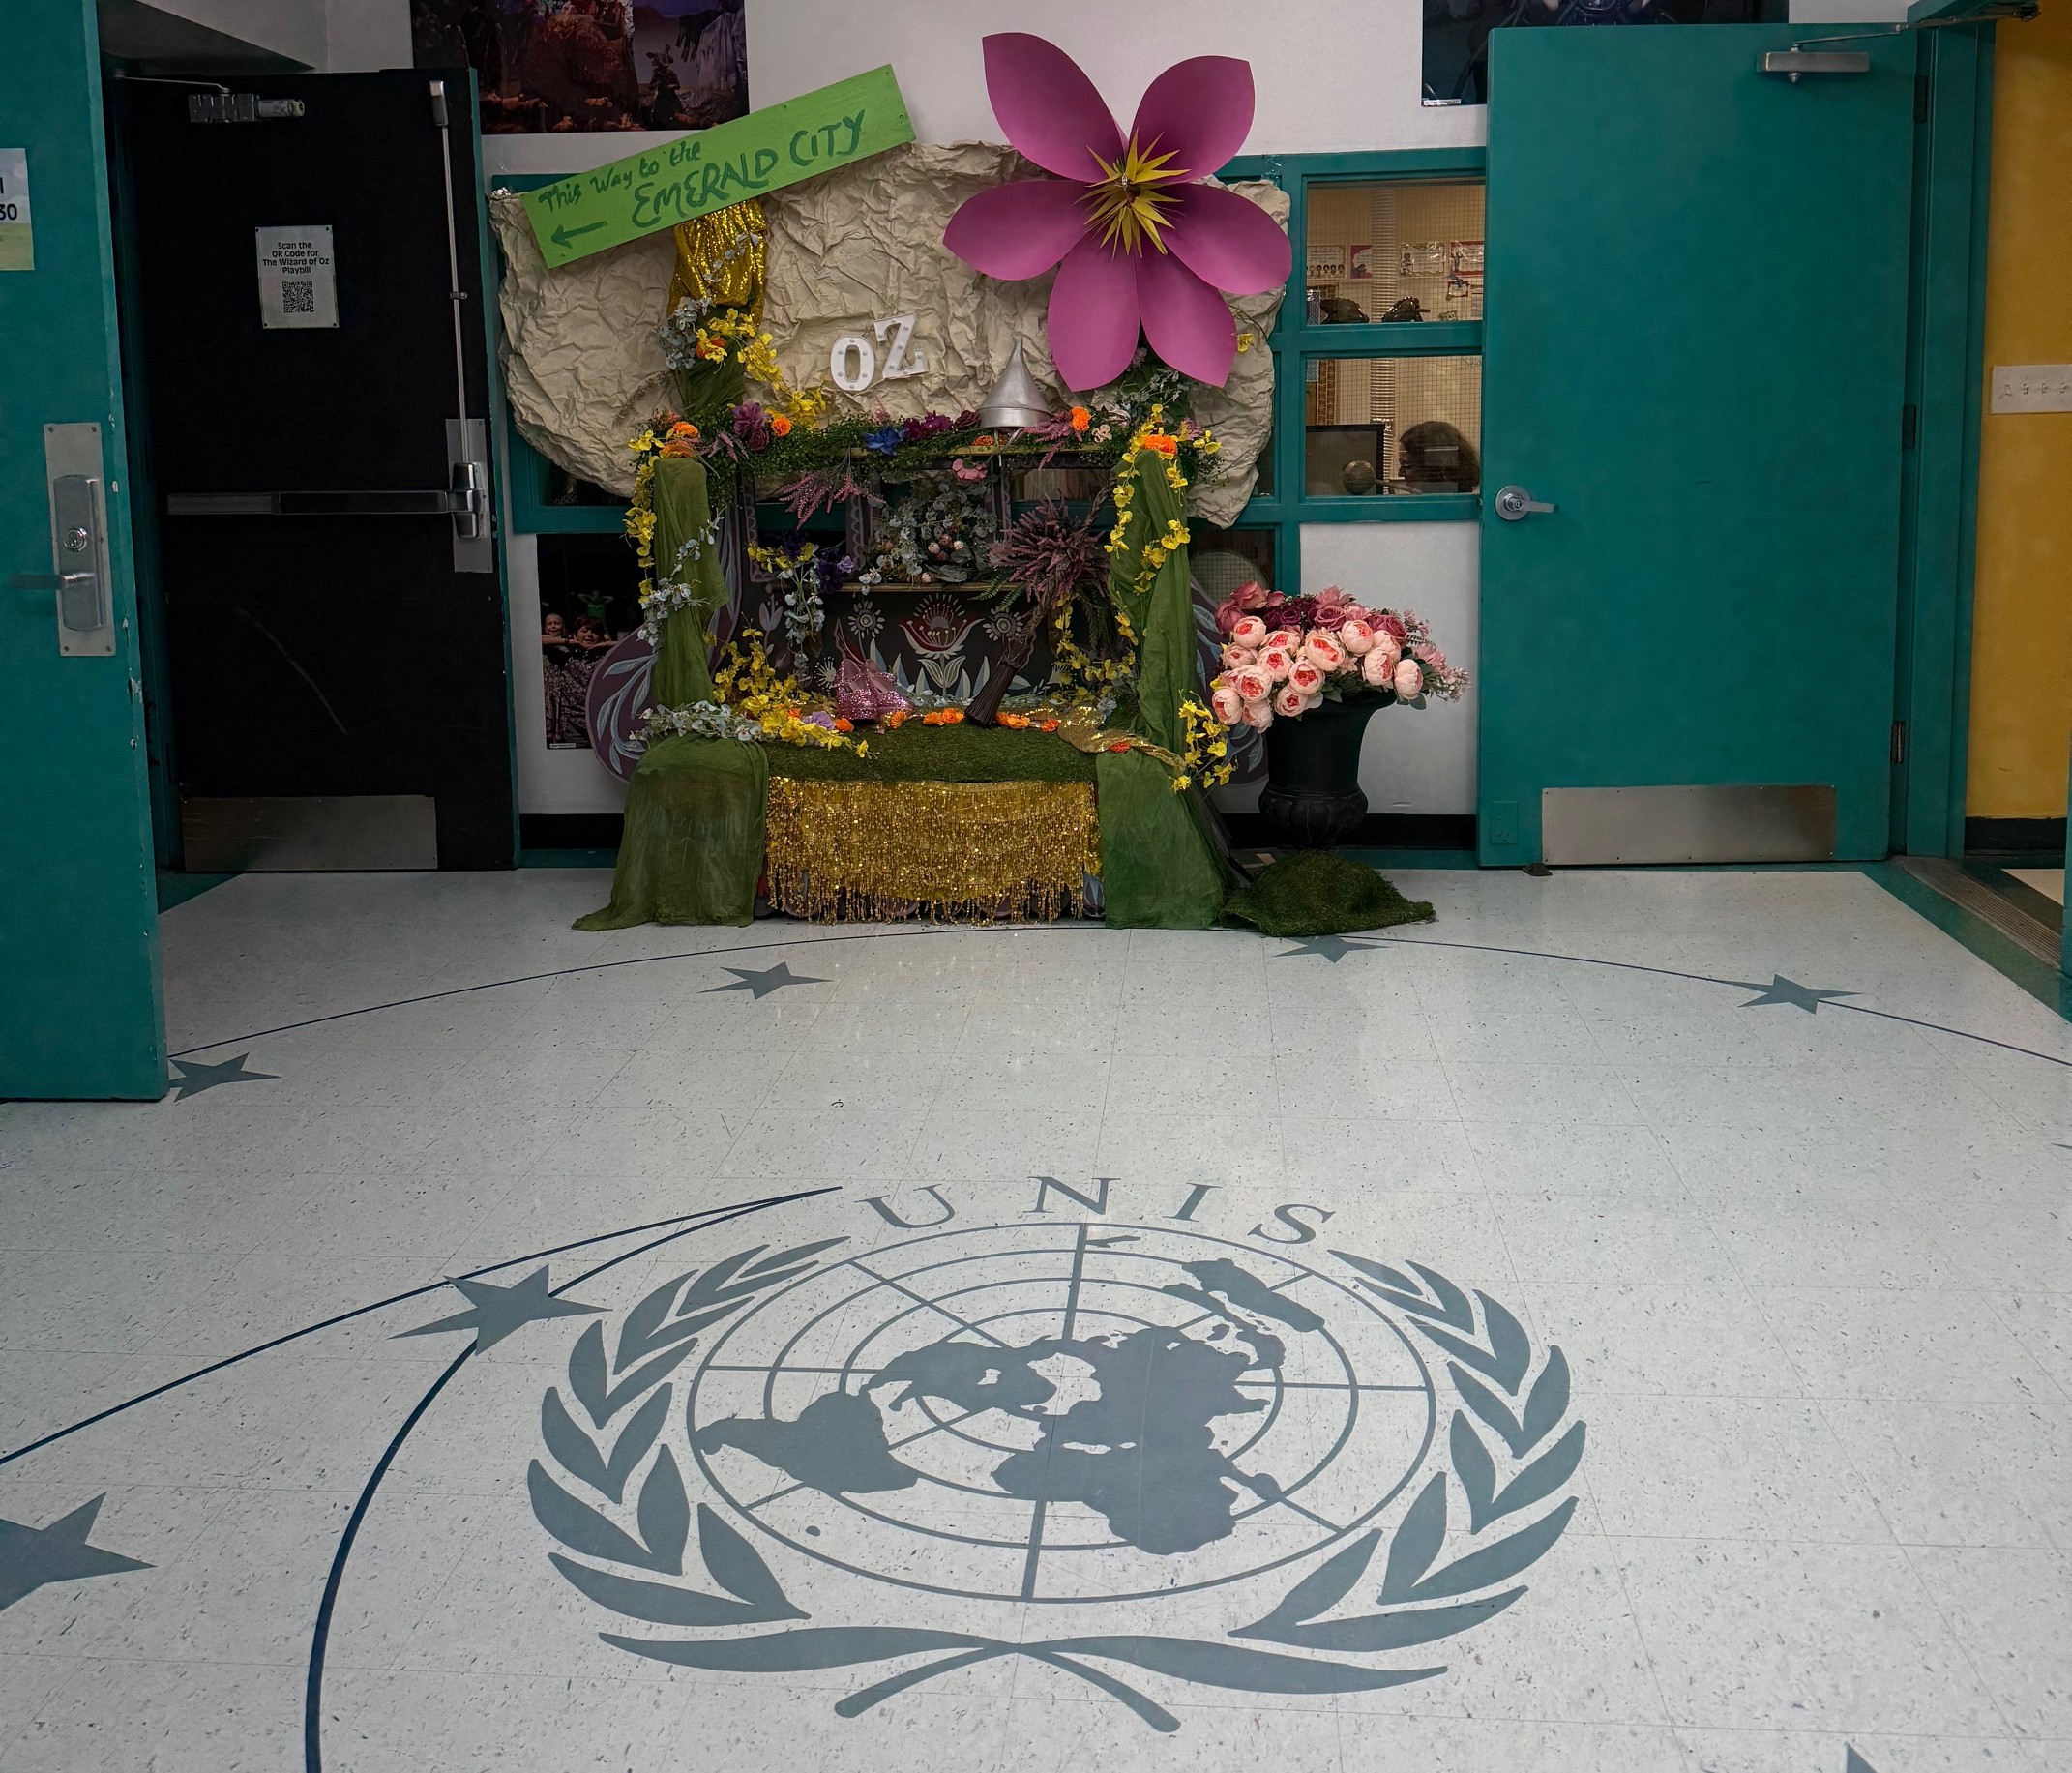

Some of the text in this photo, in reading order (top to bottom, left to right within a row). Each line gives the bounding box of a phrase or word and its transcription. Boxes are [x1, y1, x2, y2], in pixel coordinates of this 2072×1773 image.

[538, 141, 701, 213] This Way to the
[632, 109, 866, 228] EMERALD CITY
[262, 258, 278, 267] The
[281, 266, 311, 275] Playbill
[830, 312, 929, 392] OZ
[854, 1175, 1336, 1245] UNIS
